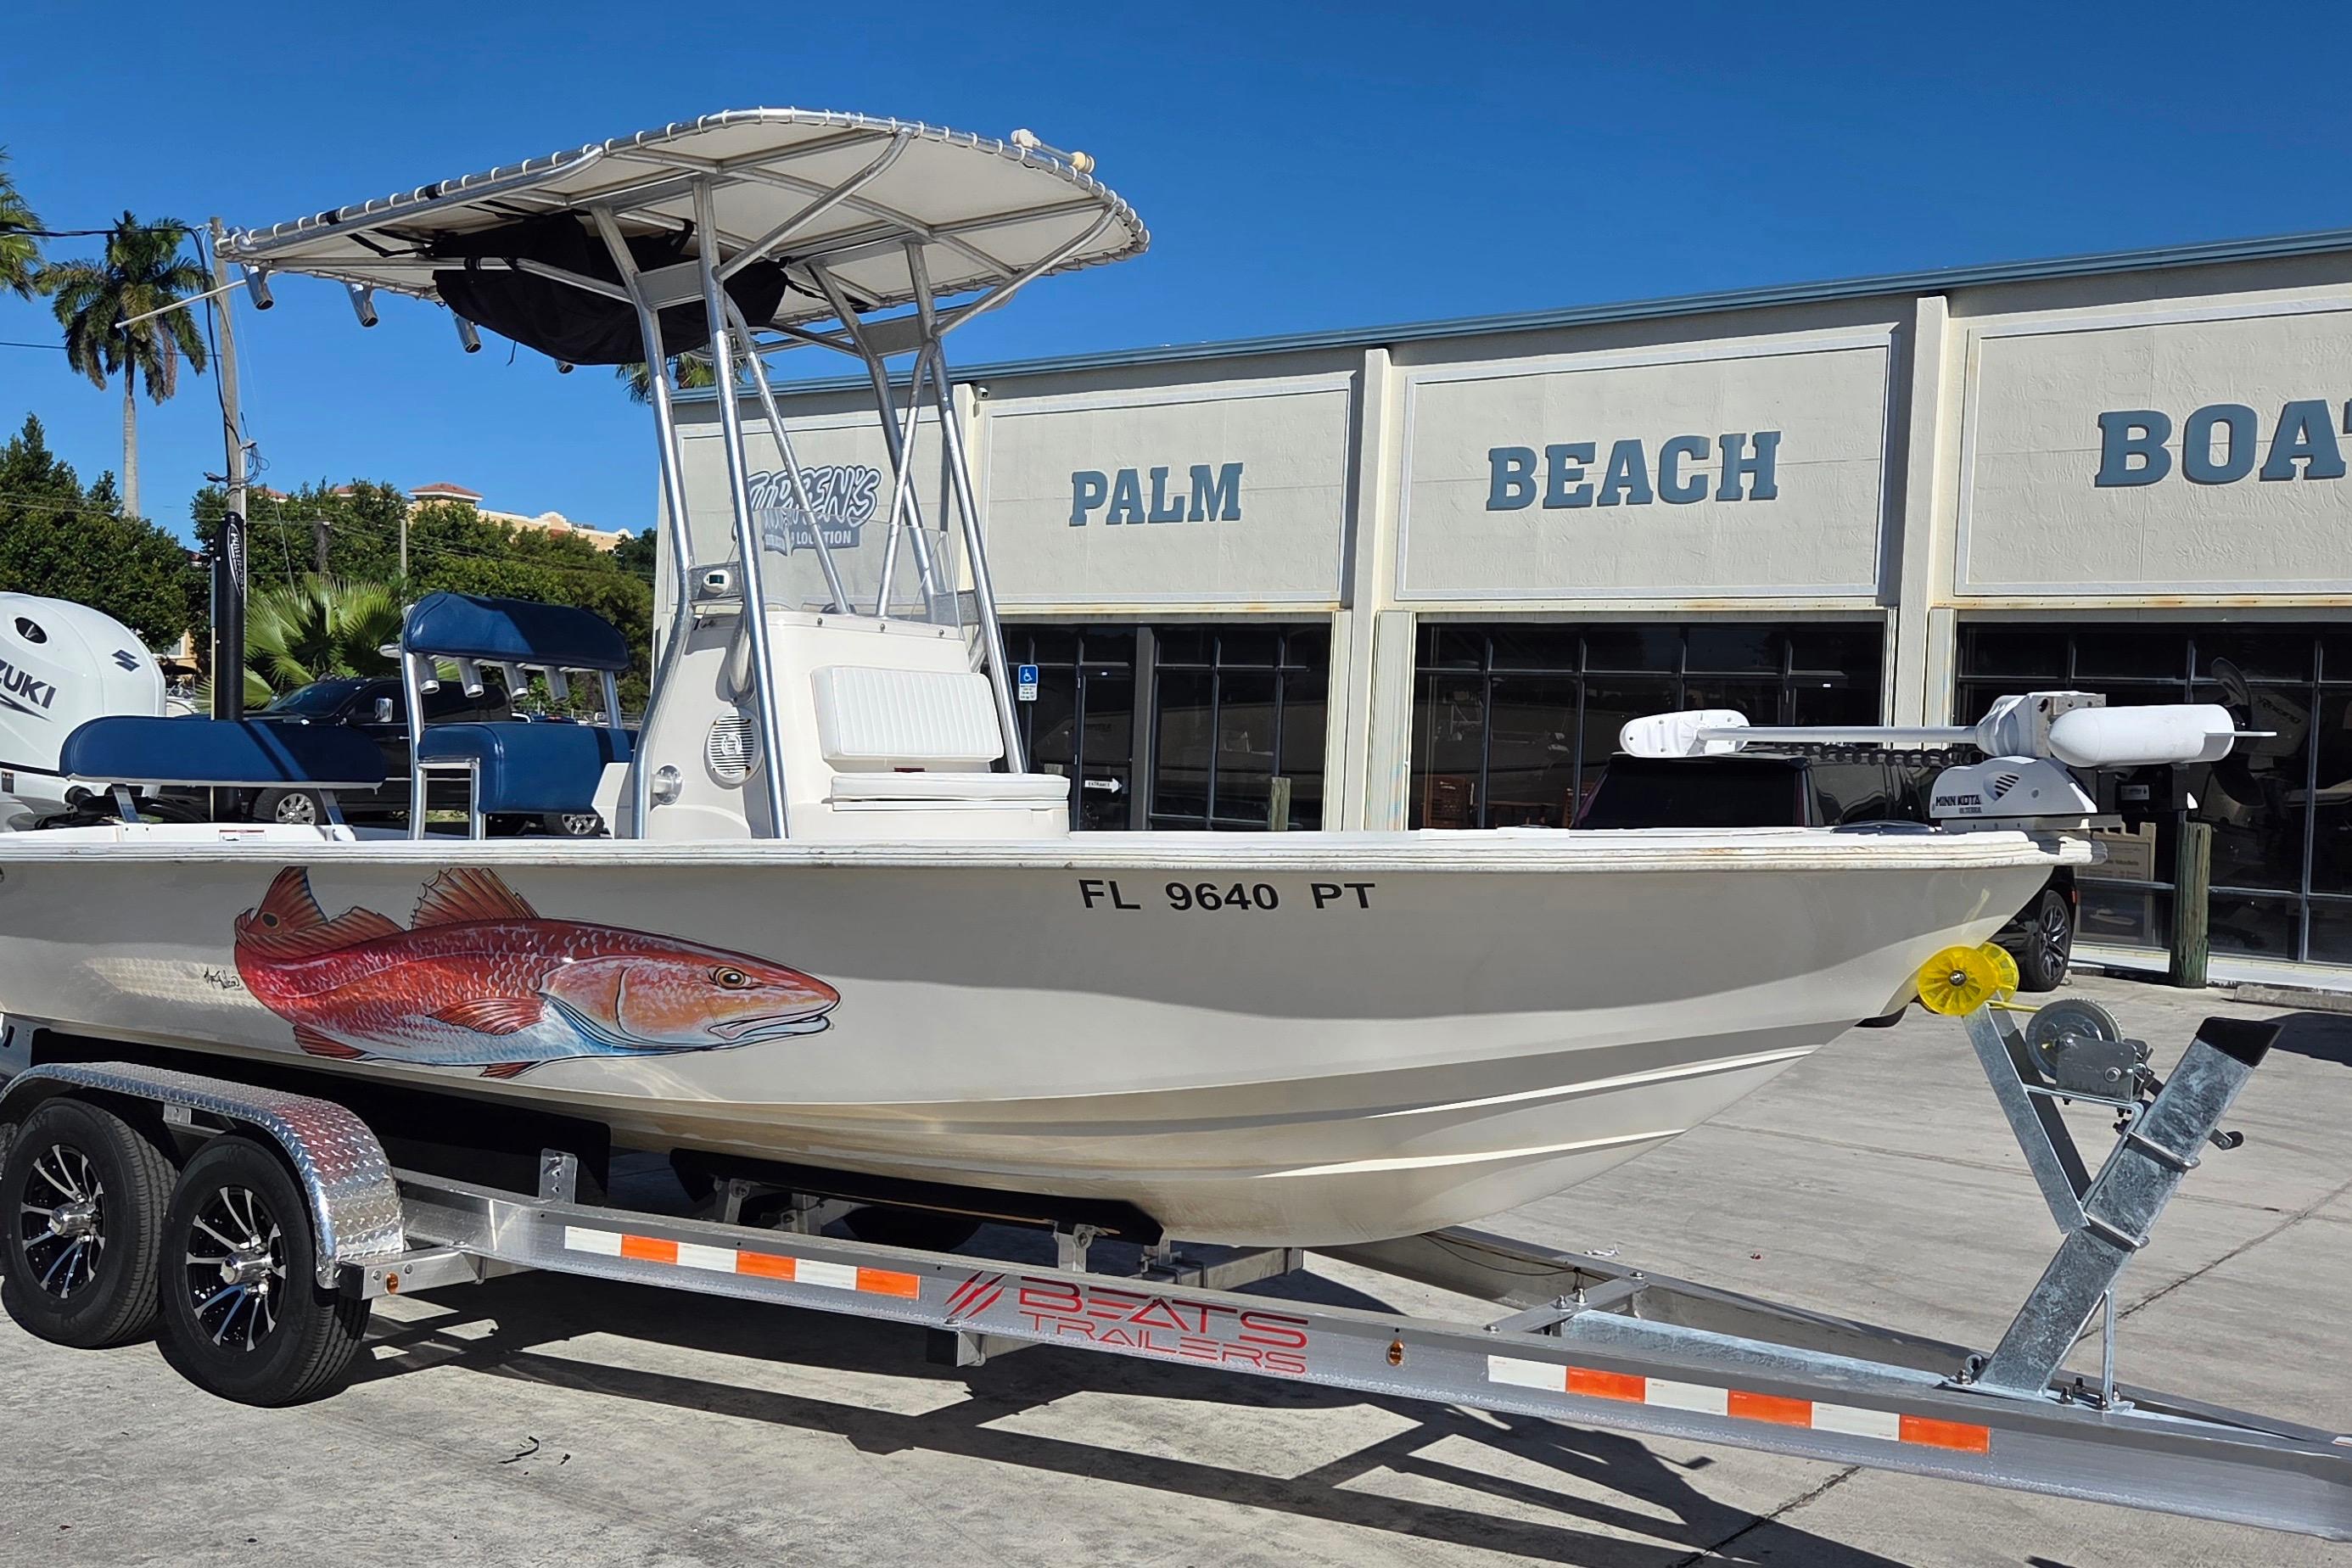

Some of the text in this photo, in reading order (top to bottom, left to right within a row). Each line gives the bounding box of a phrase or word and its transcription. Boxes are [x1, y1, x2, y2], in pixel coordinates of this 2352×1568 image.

[1069, 398, 2352, 527] PALM BEACH BOA
[796, 530, 852, 545] LOCTION
[1935, 794, 1981, 806] MINN KOTA
[1078, 880, 1375, 910] FL 9640 PT
[1019, 1275, 1308, 1349] BEATS
[1019, 1311, 1307, 1374] TRAILERS
